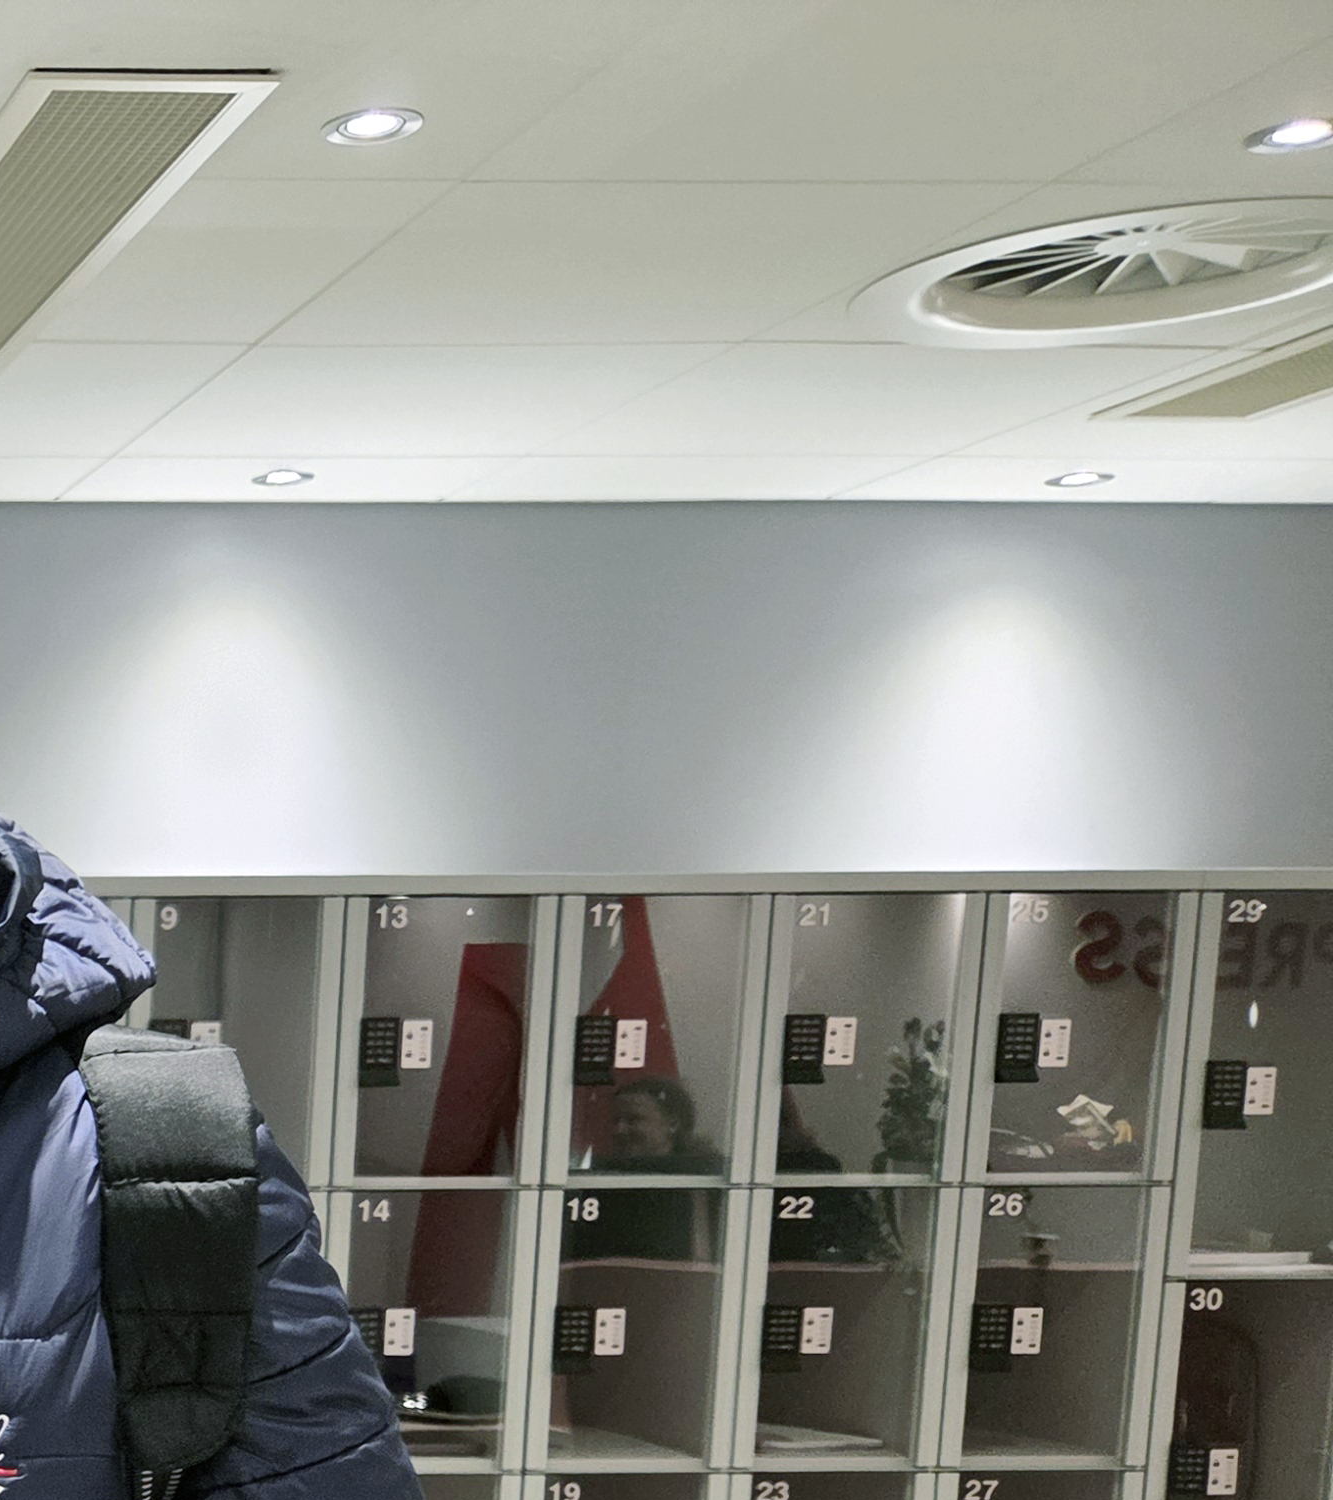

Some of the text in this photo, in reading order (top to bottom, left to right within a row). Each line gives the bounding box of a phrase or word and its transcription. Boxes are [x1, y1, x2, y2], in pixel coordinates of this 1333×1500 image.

[160, 906, 179, 931] 9
[376, 904, 409, 930] 13
[590, 903, 623, 928] 17
[799, 903, 831, 927] 21
[1012, 899, 1049, 924] 25
[1228, 899, 1263, 923] 29
[358, 1199, 390, 1223] 14
[567, 1198, 600, 1222] 18
[778, 1196, 814, 1220] 22
[988, 1194, 1024, 1216] 26
[1190, 1288, 1223, 1312] 30
